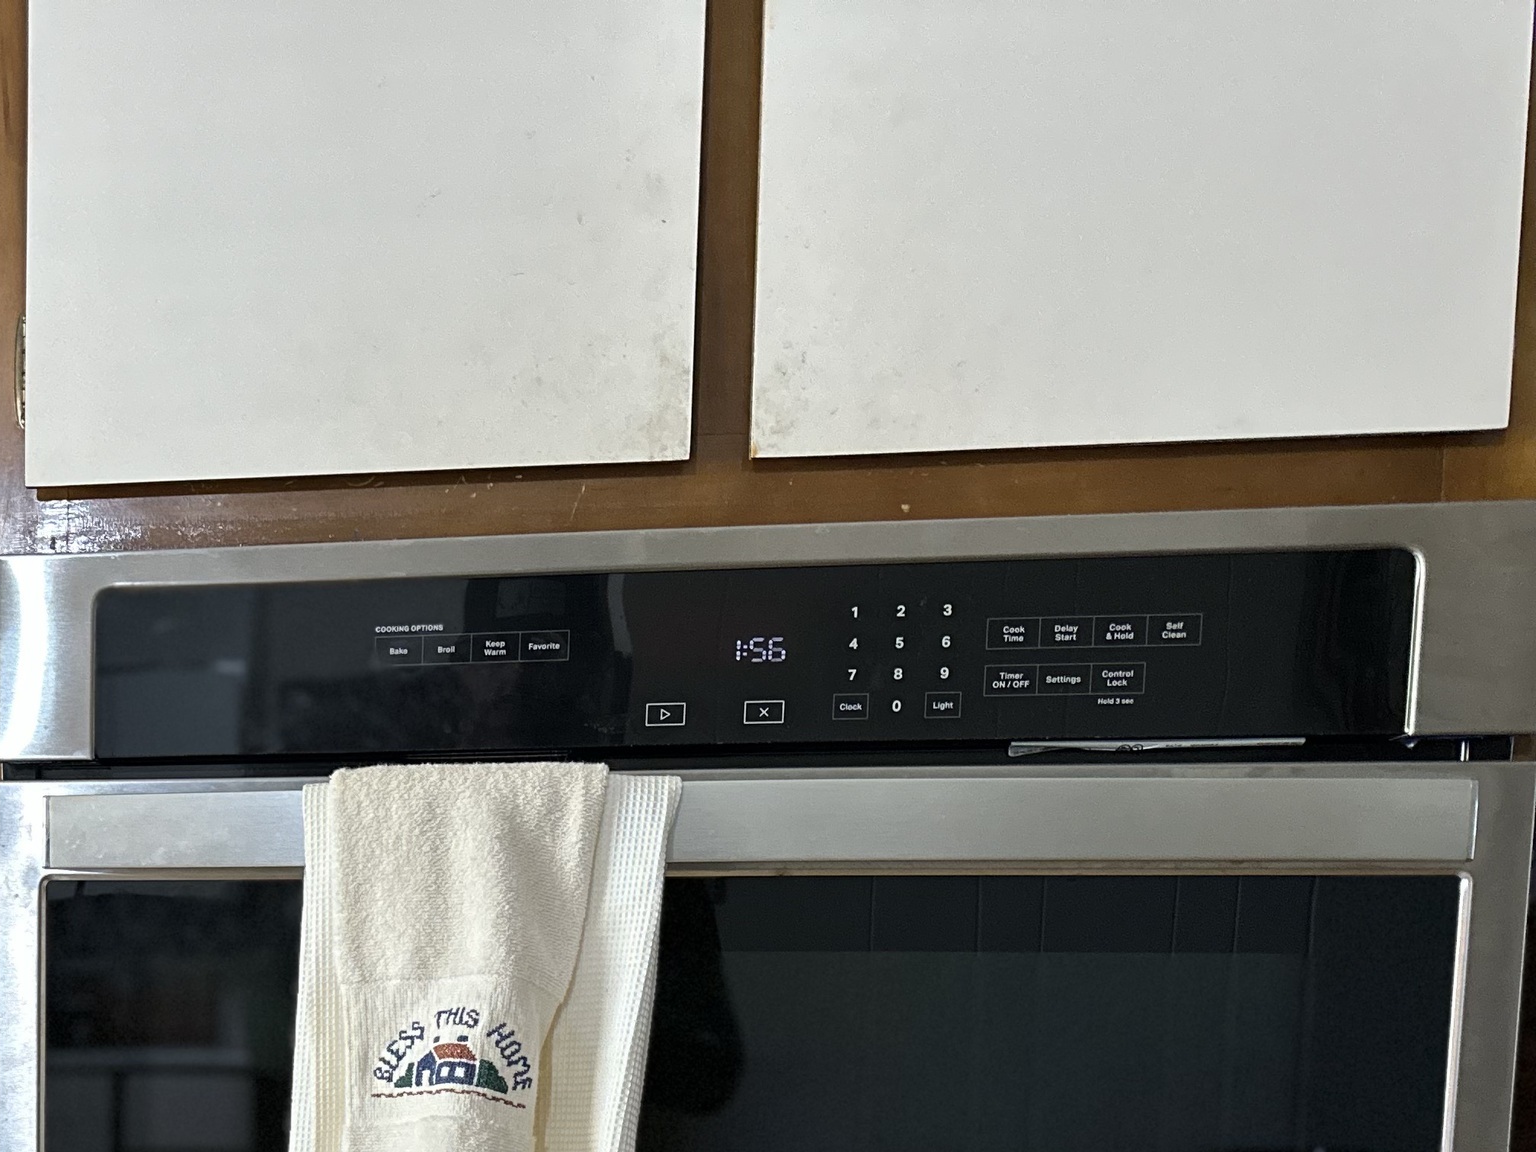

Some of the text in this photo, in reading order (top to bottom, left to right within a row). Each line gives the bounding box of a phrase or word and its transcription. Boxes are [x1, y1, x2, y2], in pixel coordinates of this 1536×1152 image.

[851, 603, 953, 618] 1 2 3
[375, 624, 444, 633] COOKING OPTIONS
[1003, 625, 1025, 634] Cook
[1054, 624, 1079, 634] Delay
[1109, 623, 1132, 632] Cook
[1166, 621, 1184, 630] Self
[1003, 634, 1024, 643] Time
[1055, 633, 1077, 642] Start
[1105, 631, 1135, 641] & Hold
[1162, 630, 1187, 639] Clean
[485, 640, 506, 649] Keep
[528, 642, 561, 651] Favorite
[848, 635, 952, 650] 4 5 6
[389, 647, 409, 656] Bake
[437, 645, 456, 654] Broil
[484, 648, 507, 657] Warm
[735, 636, 787, 663] 1:56
[847, 666, 950, 681] 7 8 9
[999, 672, 1024, 680] Timer
[1102, 670, 1134, 678] Control
[992, 681, 1005, 689] ON
[1012, 680, 1030, 689] OFF
[1045, 676, 1082, 685] Settings
[1107, 679, 1128, 687] Lock
[839, 700, 954, 713] Clock 0 Light
[373, 1006, 533, 1092] BLESS THIS HOME
